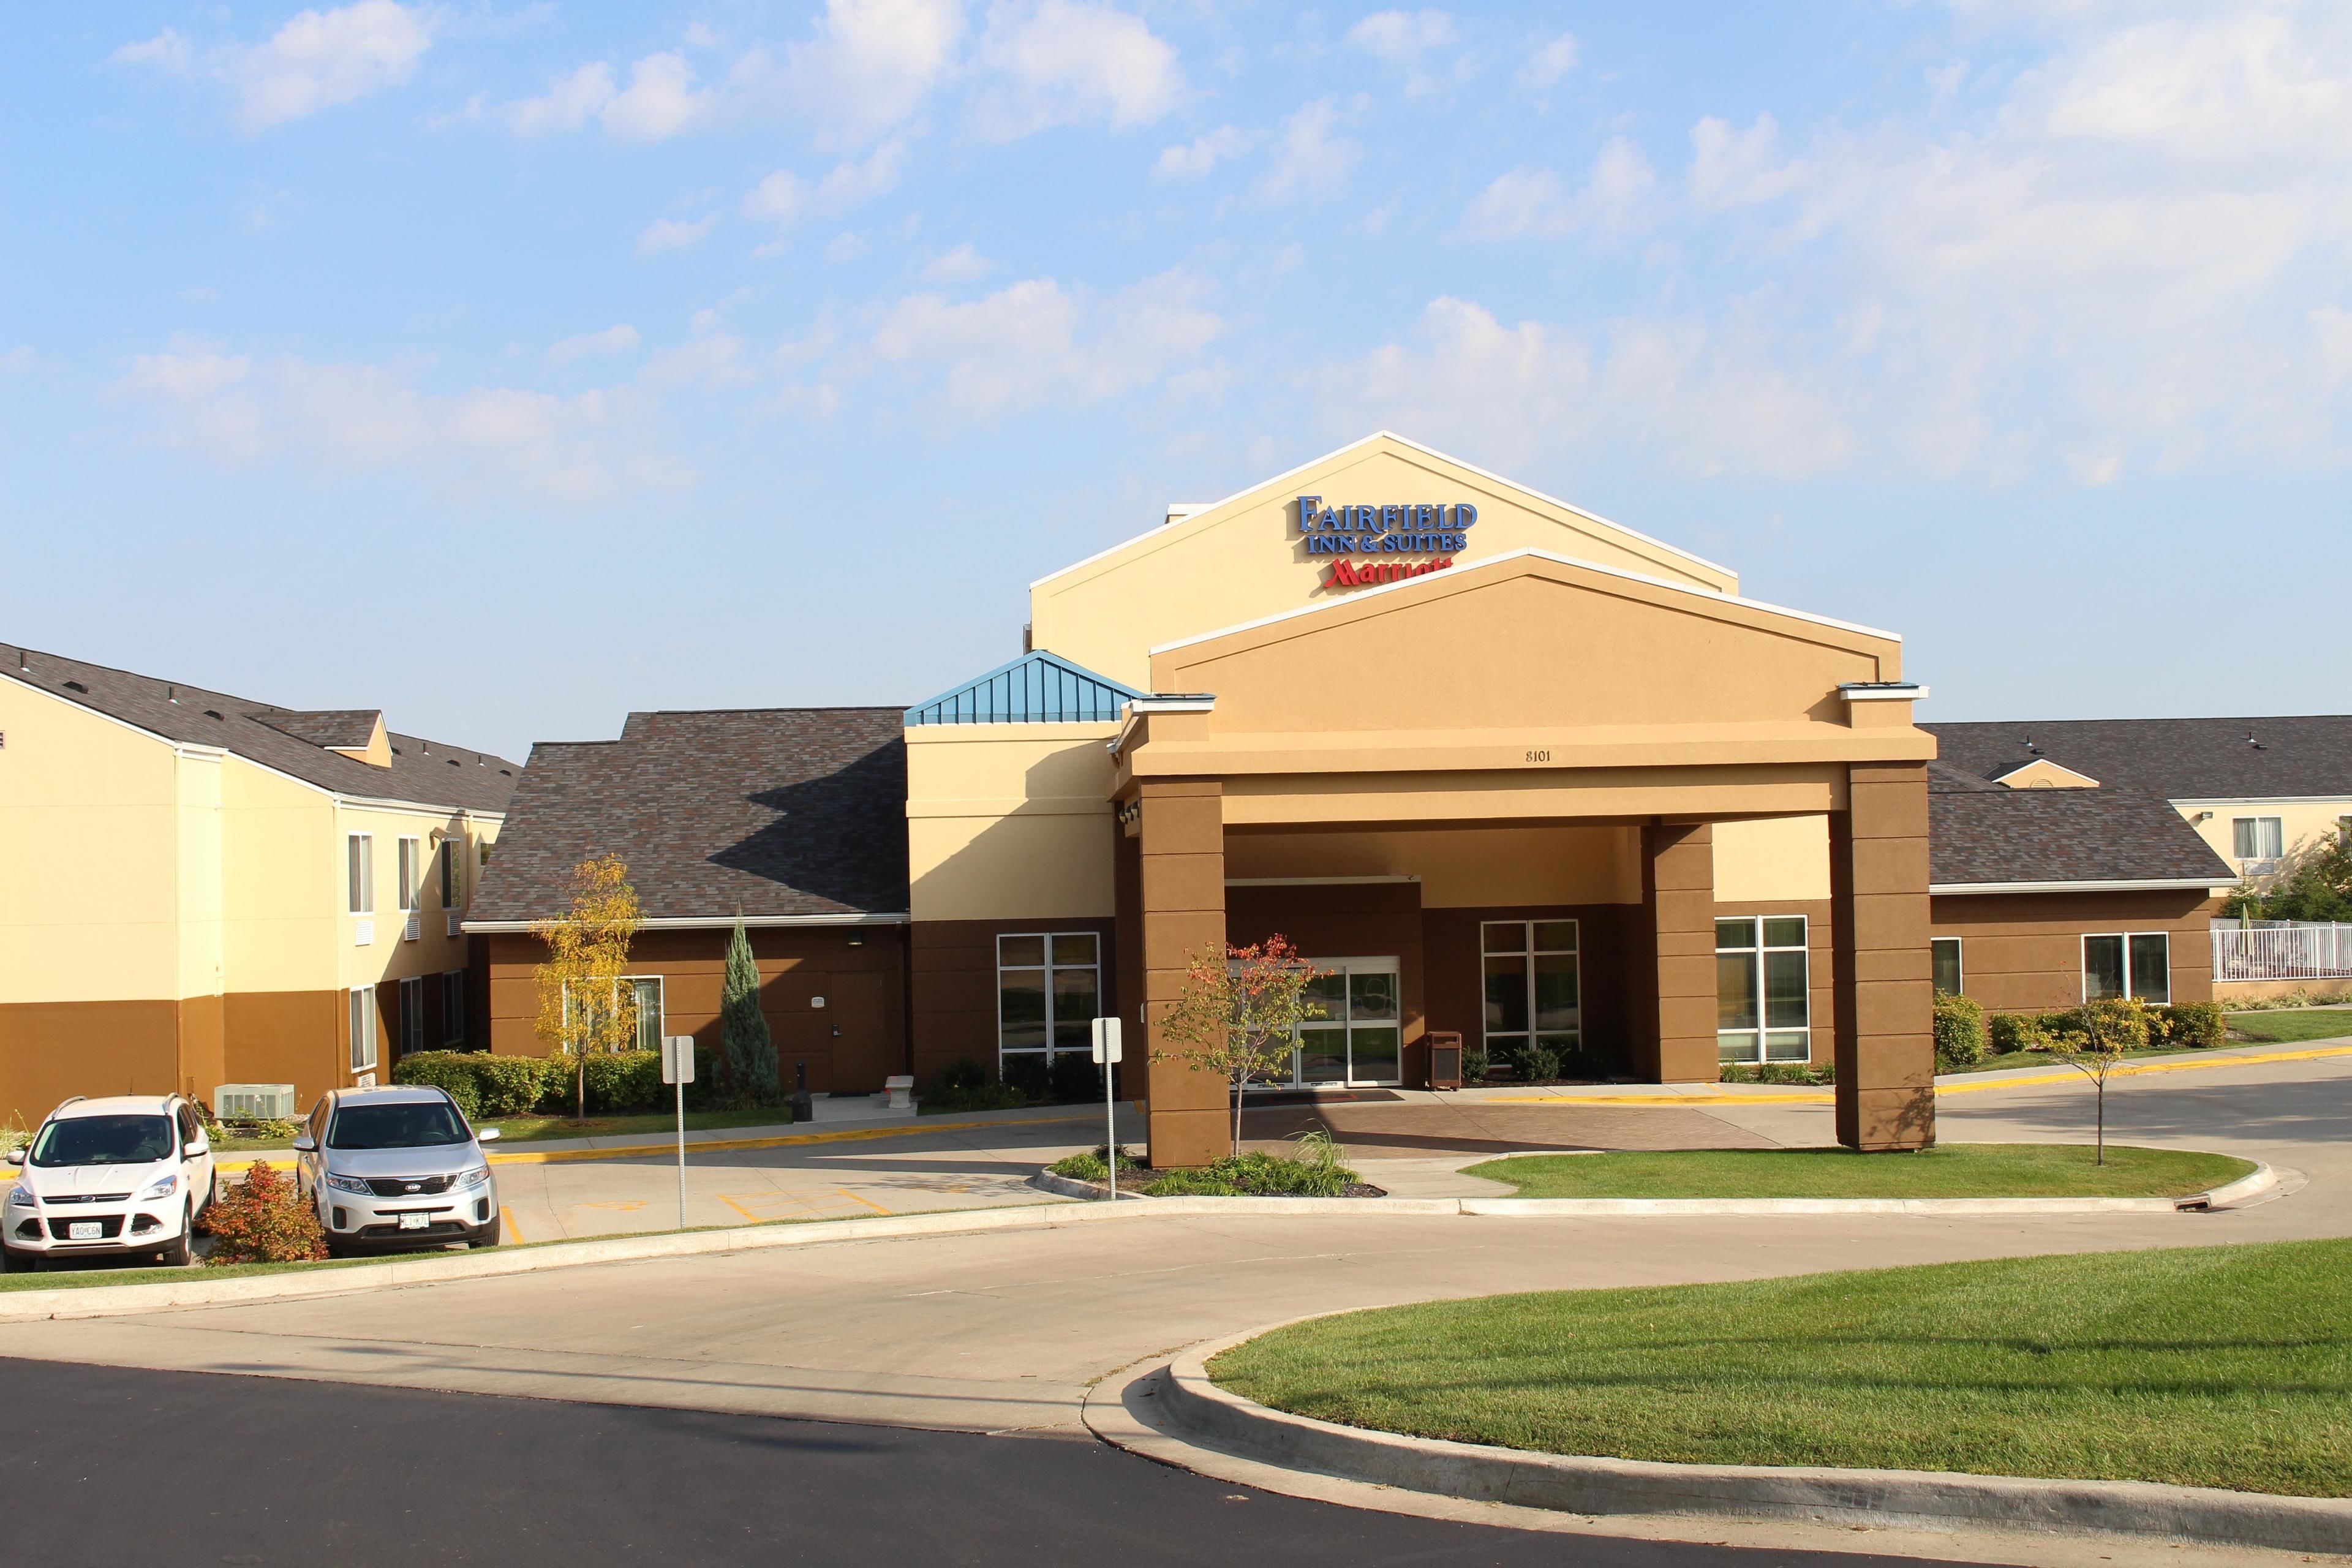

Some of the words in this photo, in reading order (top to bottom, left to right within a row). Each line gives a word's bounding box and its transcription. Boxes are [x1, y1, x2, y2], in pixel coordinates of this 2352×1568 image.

[1297, 496, 1477, 533] FAIRFIELD
[1306, 534, 1357, 554] INN
[1360, 534, 1381, 554] &
[1383, 533, 1467, 553] SUITES
[1525, 750, 1550, 763] 8101
